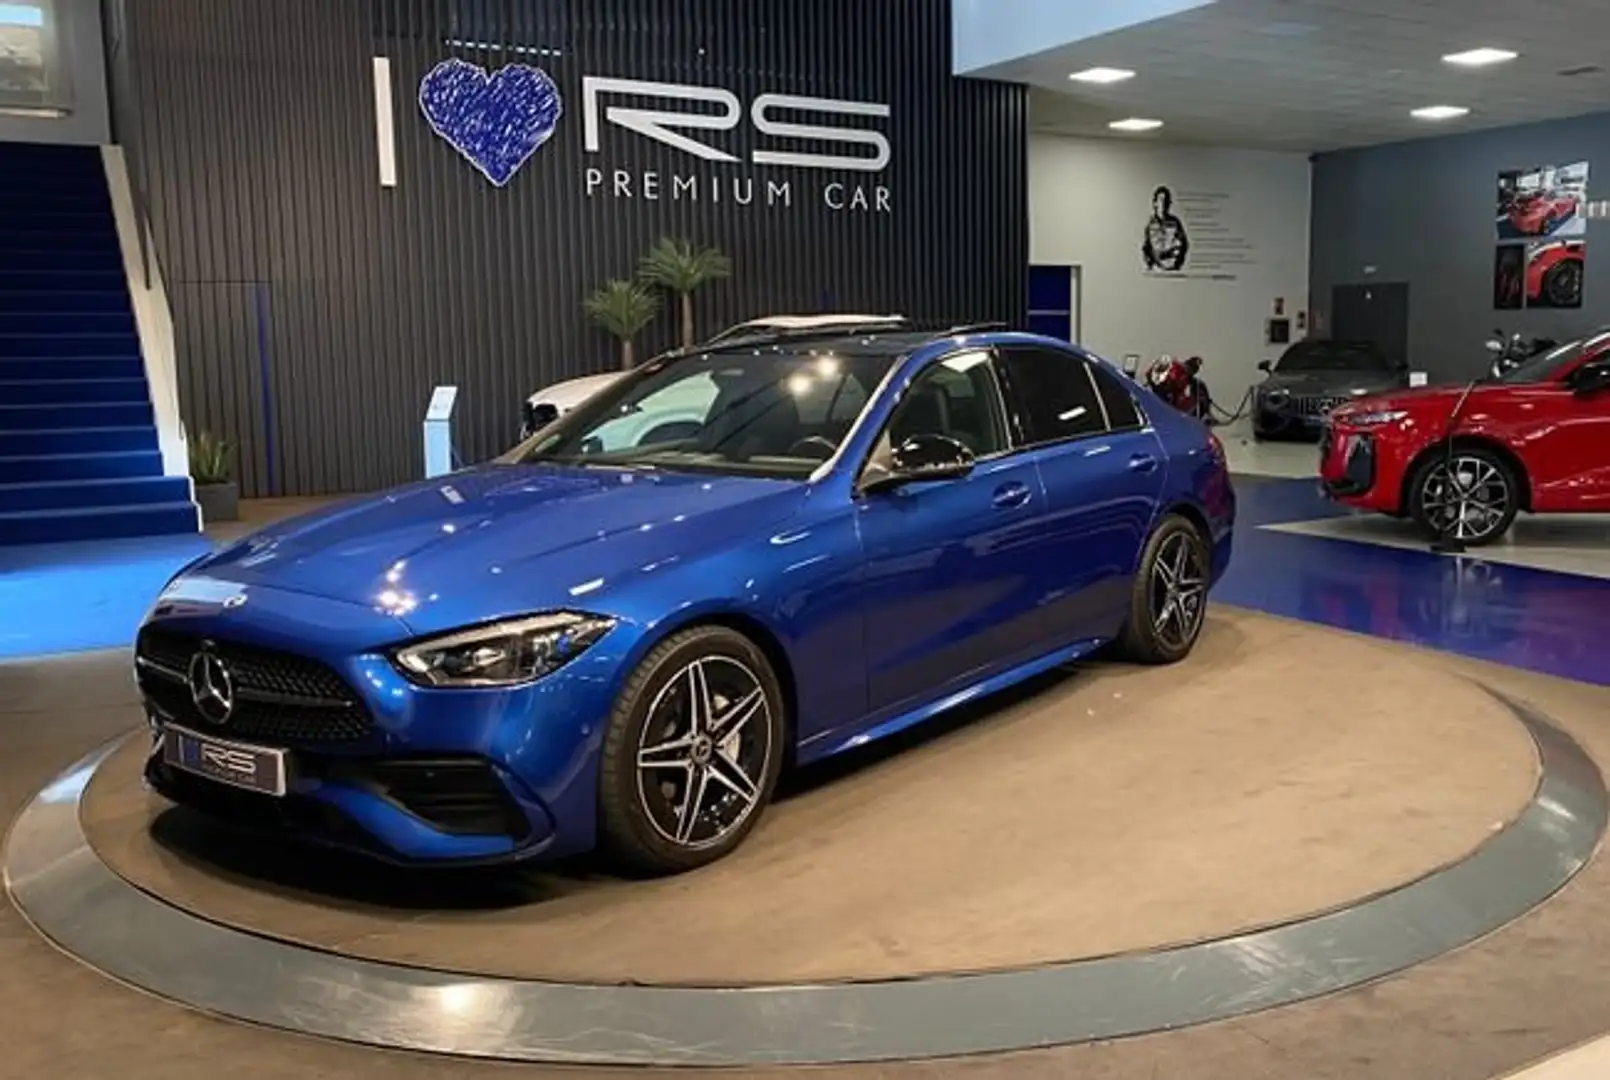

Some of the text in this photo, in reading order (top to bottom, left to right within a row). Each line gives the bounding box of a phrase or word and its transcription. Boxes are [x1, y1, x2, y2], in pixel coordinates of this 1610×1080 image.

[582, 75, 891, 172] RS
[586, 168, 892, 213] PREMIUM CAR
[201, 742, 256, 774] RS
